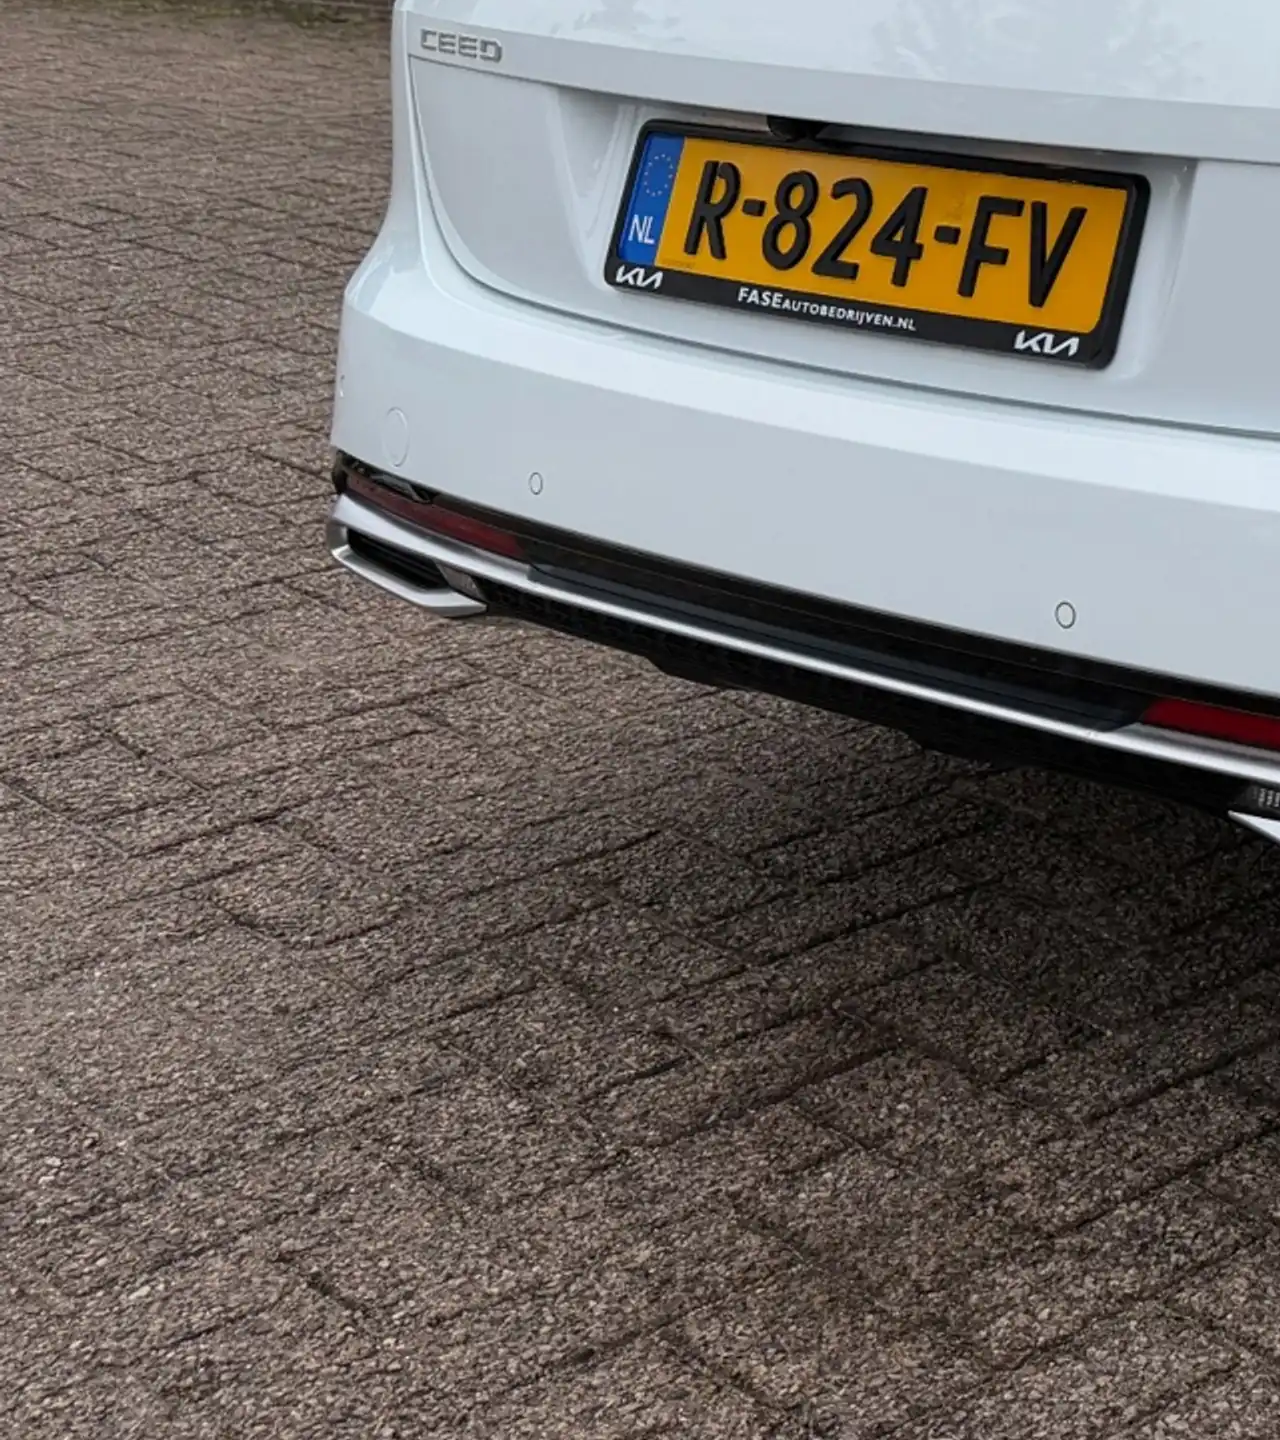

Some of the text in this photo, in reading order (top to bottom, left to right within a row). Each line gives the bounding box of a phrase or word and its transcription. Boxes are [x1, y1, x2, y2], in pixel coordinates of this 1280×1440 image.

[421, 28, 503, 63] CEED
[628, 213, 656, 245] NL
[683, 160, 1087, 309] R-824-FV
[616, 264, 663, 289] KIA
[1014, 329, 1080, 357] KIA
